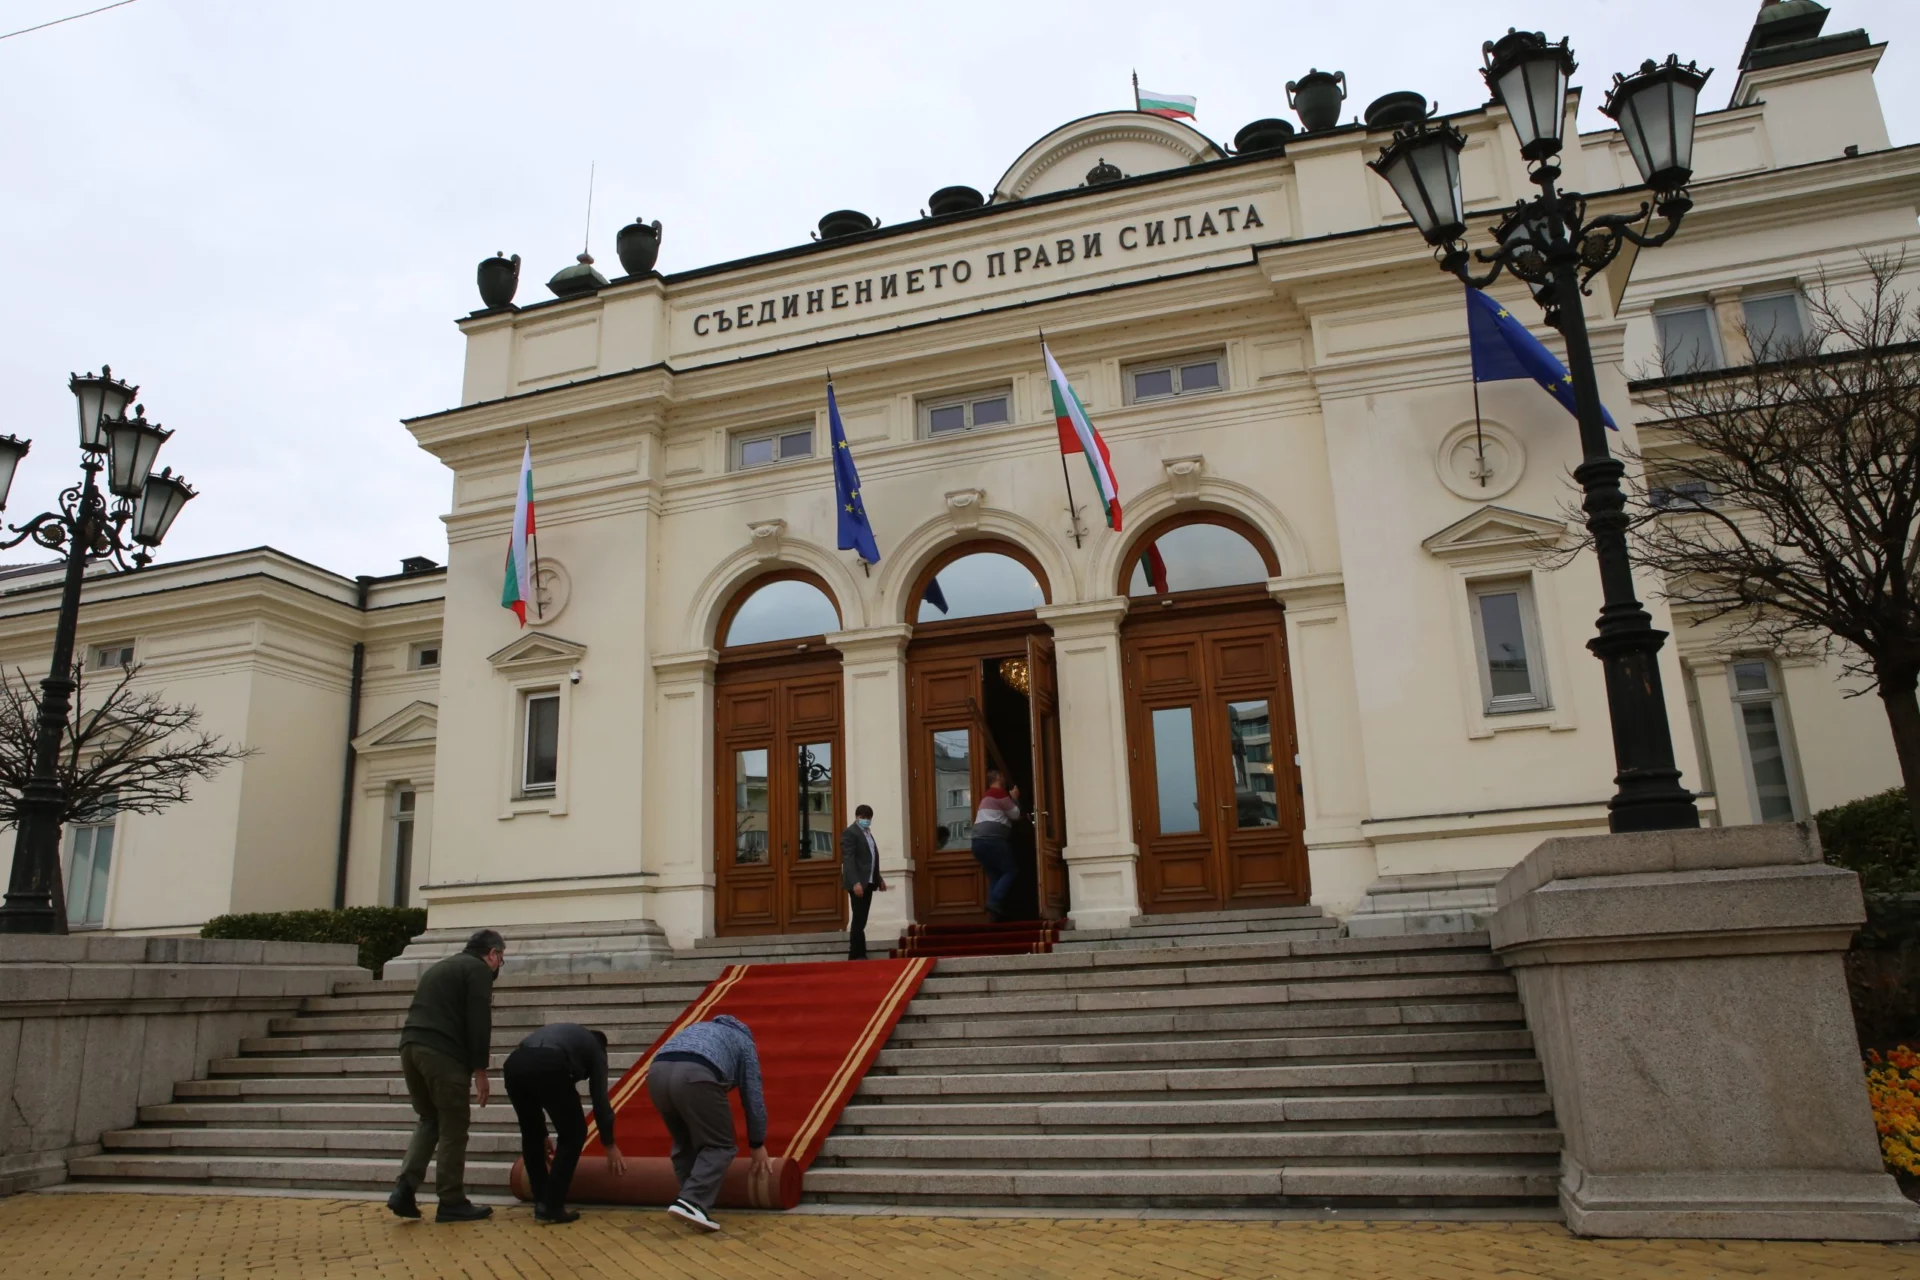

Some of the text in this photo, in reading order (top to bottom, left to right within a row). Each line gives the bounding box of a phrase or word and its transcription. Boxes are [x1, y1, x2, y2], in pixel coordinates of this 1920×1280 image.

[694, 203, 1264, 336] СЪЕДИНЕНИЕТО ПРАВИ СИЛАТА
